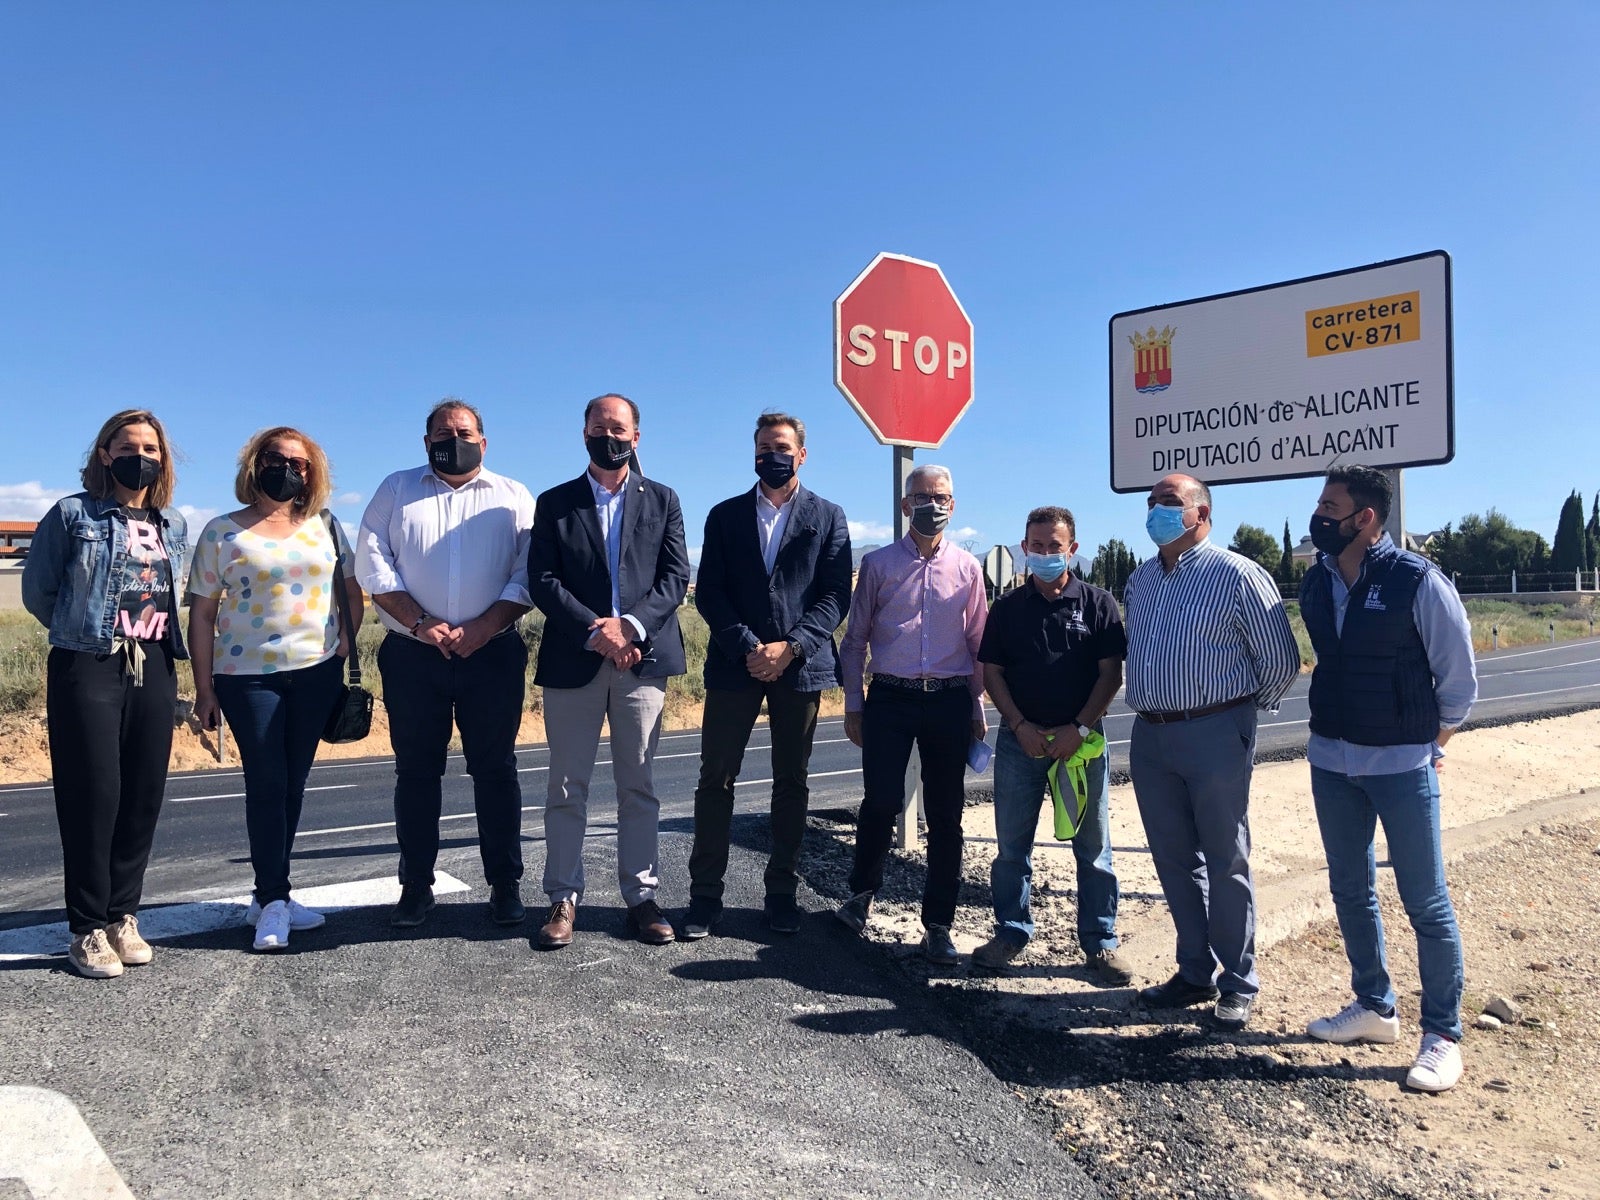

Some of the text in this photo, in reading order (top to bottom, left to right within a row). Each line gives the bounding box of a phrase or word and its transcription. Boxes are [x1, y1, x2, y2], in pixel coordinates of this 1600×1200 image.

[1312, 300, 1412, 329] carretera
[846, 324, 967, 380] STOP
[1325, 323, 1401, 351] CV-871
[1135, 380, 1420, 438] DIPUTACIÓN de ALICANTE
[1153, 436, 1260, 472] DIPUTACIÓ
